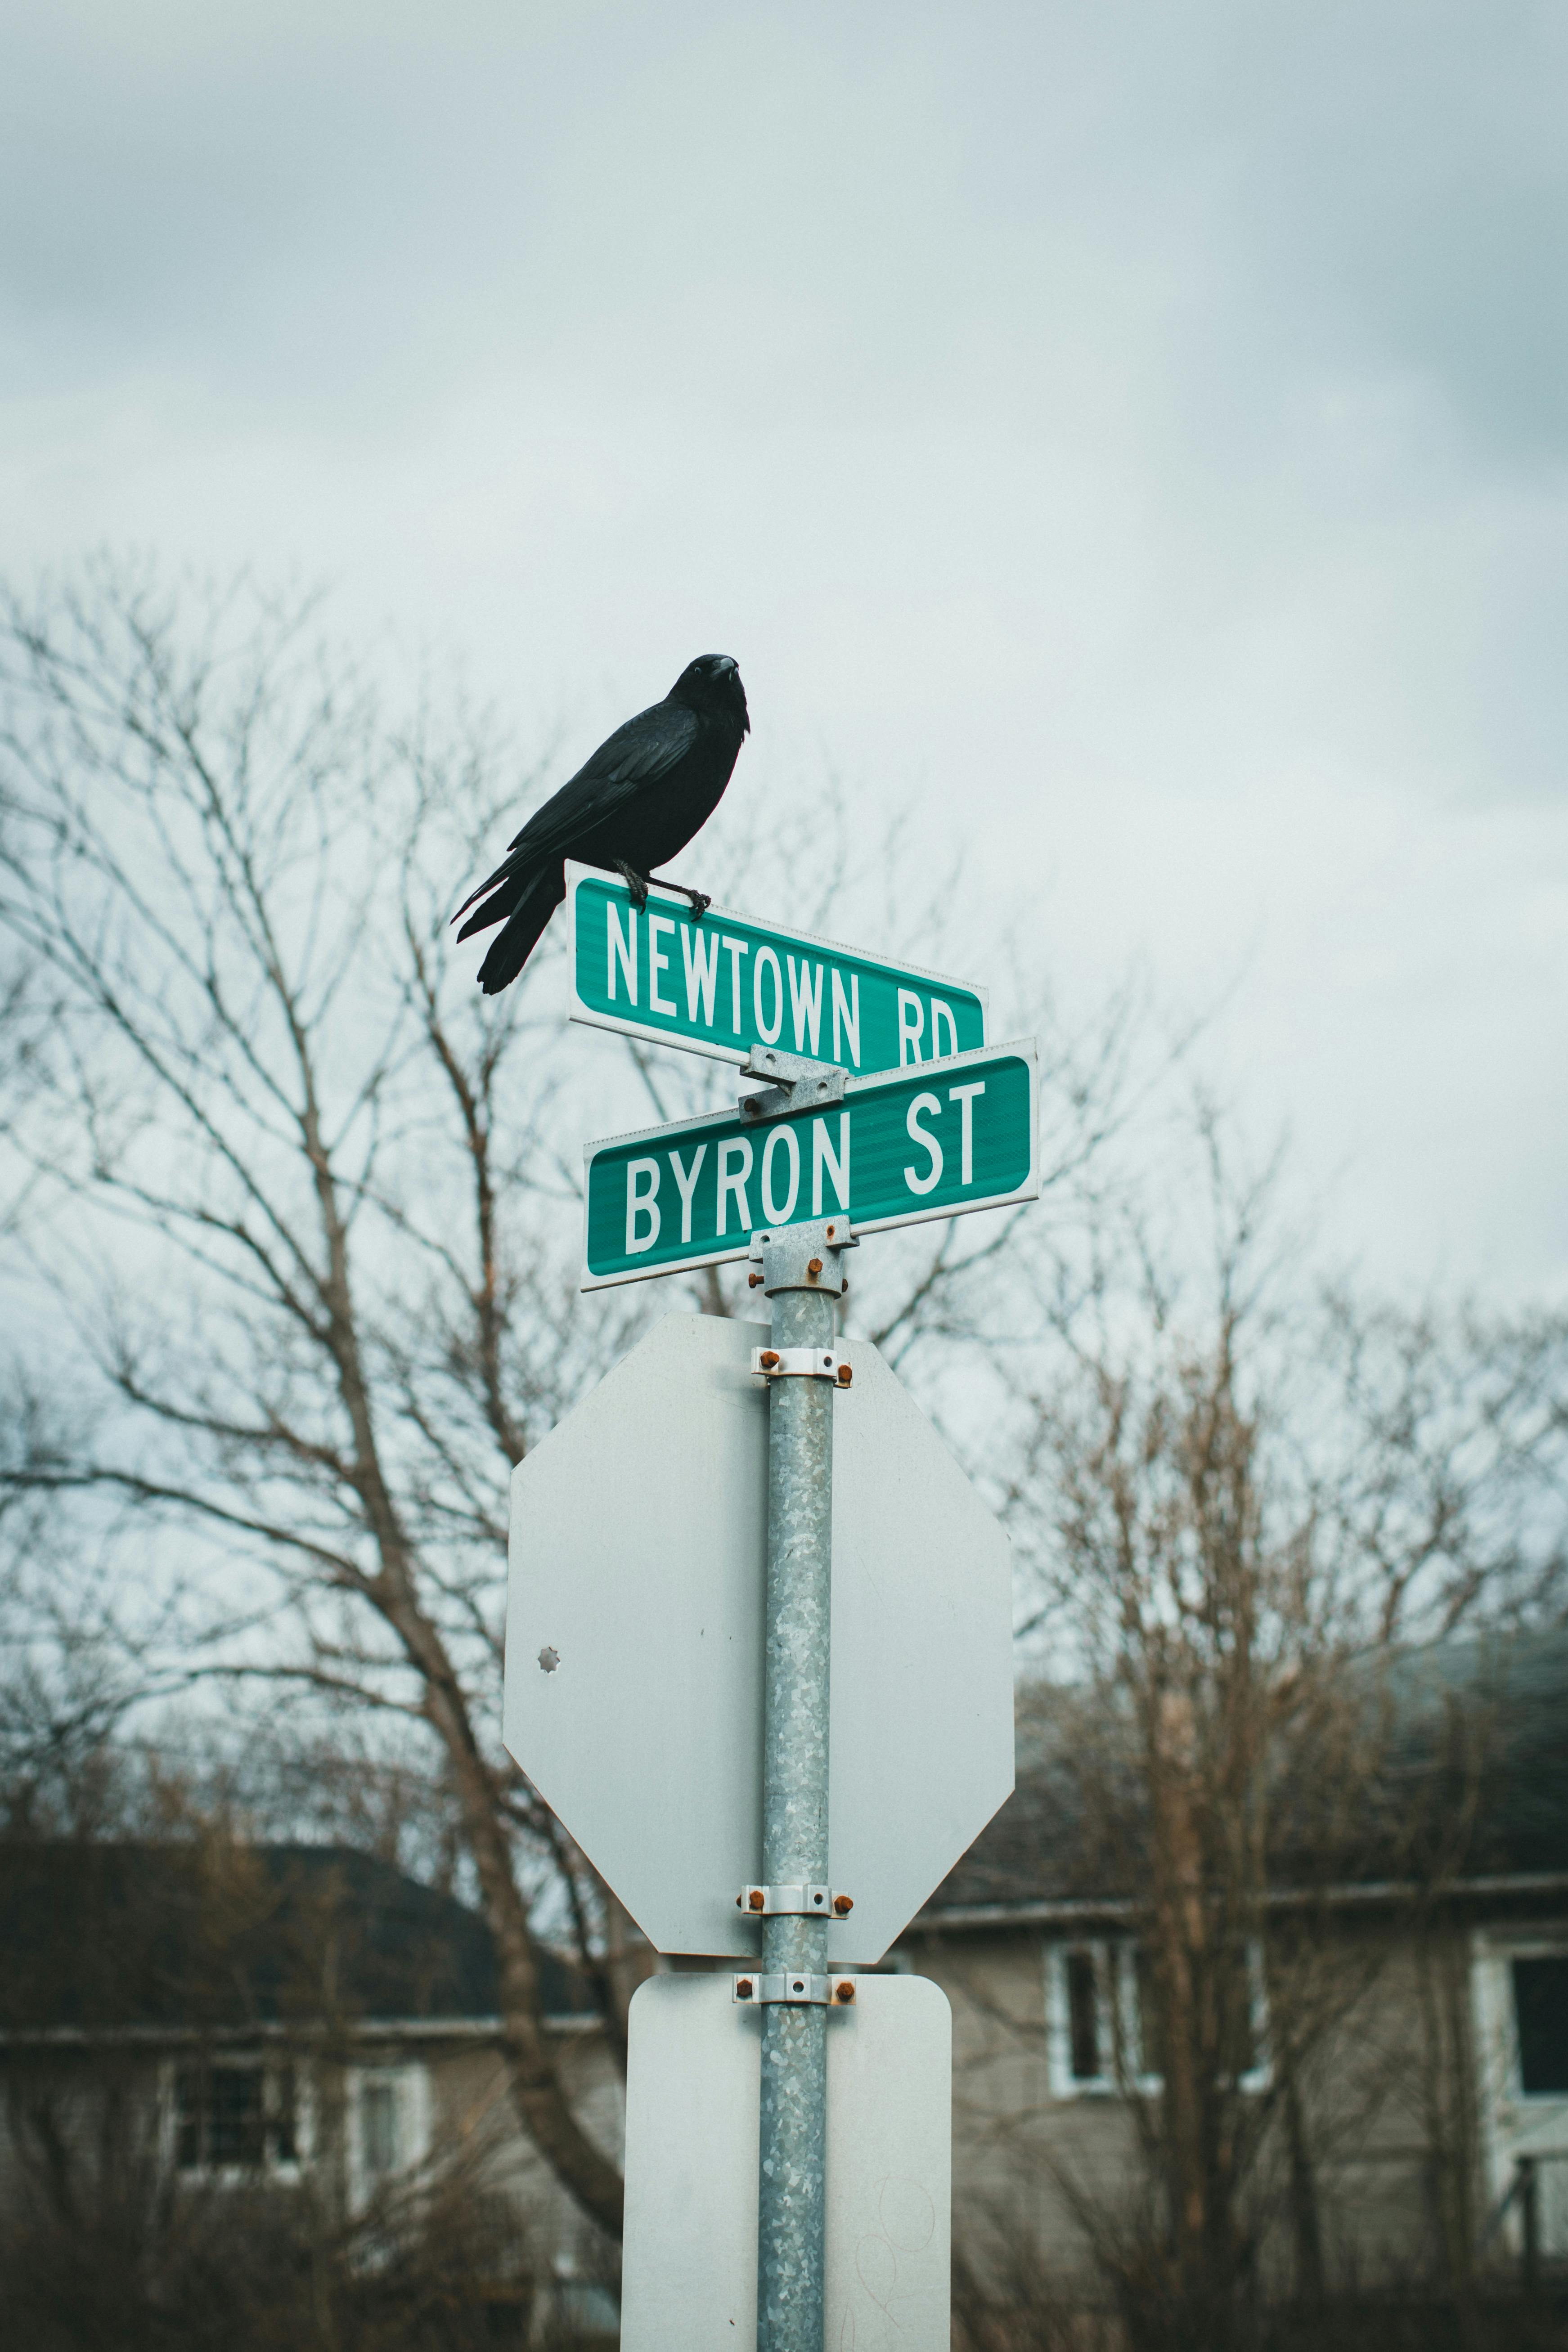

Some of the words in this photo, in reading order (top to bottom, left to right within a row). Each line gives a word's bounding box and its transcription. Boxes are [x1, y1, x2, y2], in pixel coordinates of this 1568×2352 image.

[607, 901, 860, 1068] NEWTOWN
[898, 987, 958, 1067] RD
[626, 1112, 850, 1255] BYRON
[904, 1082, 985, 1195] ST
